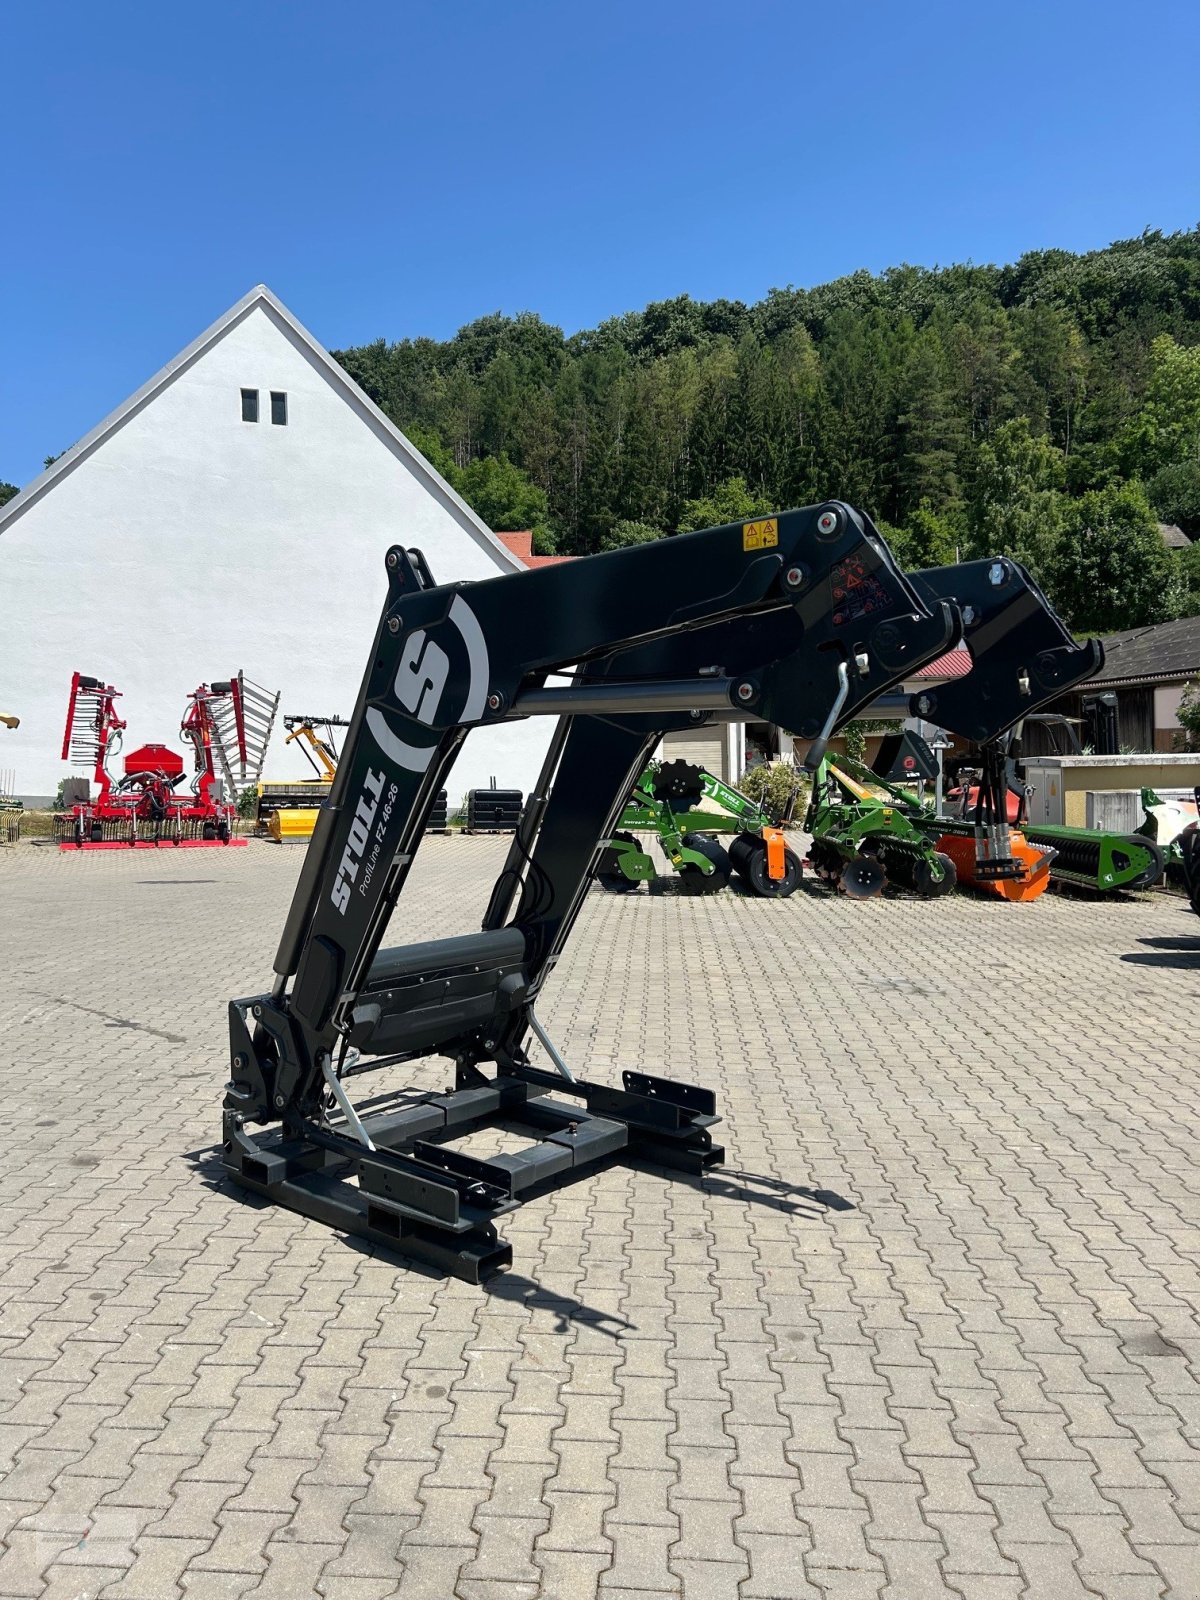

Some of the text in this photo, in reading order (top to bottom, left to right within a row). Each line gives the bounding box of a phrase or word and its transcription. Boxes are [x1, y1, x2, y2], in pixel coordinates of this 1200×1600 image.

[331, 767, 387, 916] STOLL
[359, 783, 399, 897] ProfiLine FZ 46-26
